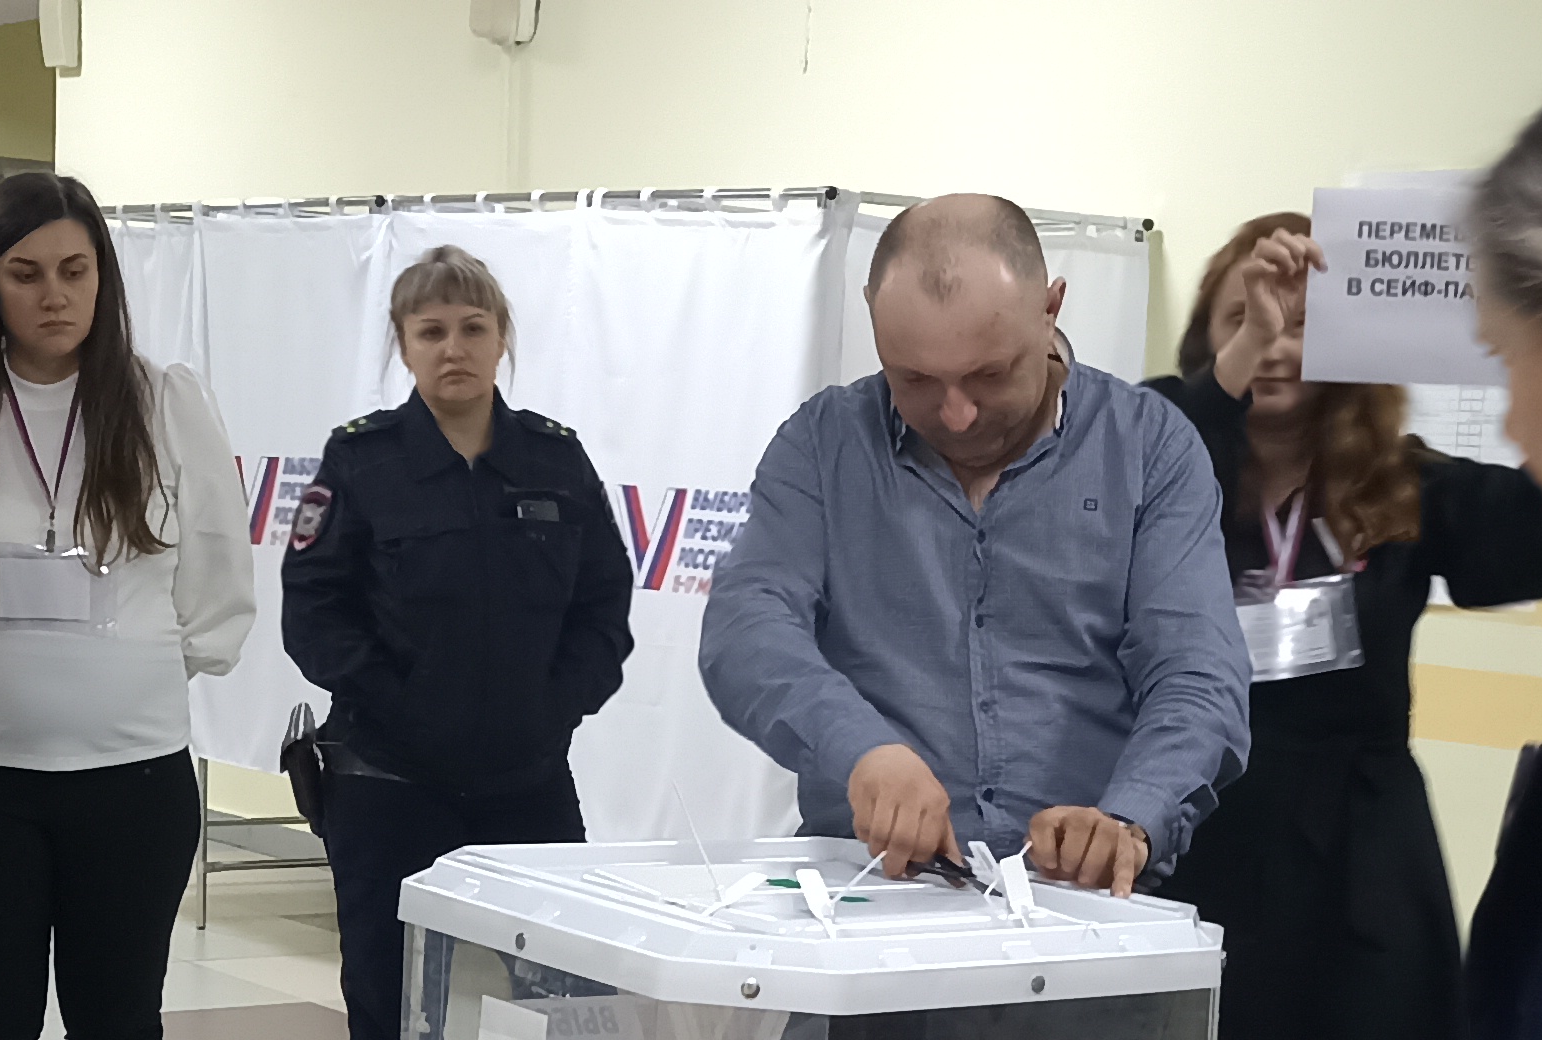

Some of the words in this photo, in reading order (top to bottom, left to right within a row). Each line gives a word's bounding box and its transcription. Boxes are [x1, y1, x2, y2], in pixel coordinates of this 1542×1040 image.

[1357, 220, 1462, 243] ПЕРЕМЕ
[1365, 249, 1477, 273] БЮЛЛЕТЕ
[1346, 277, 1362, 296] В
[1370, 276, 1475, 299] СЕЙФ-ПА
